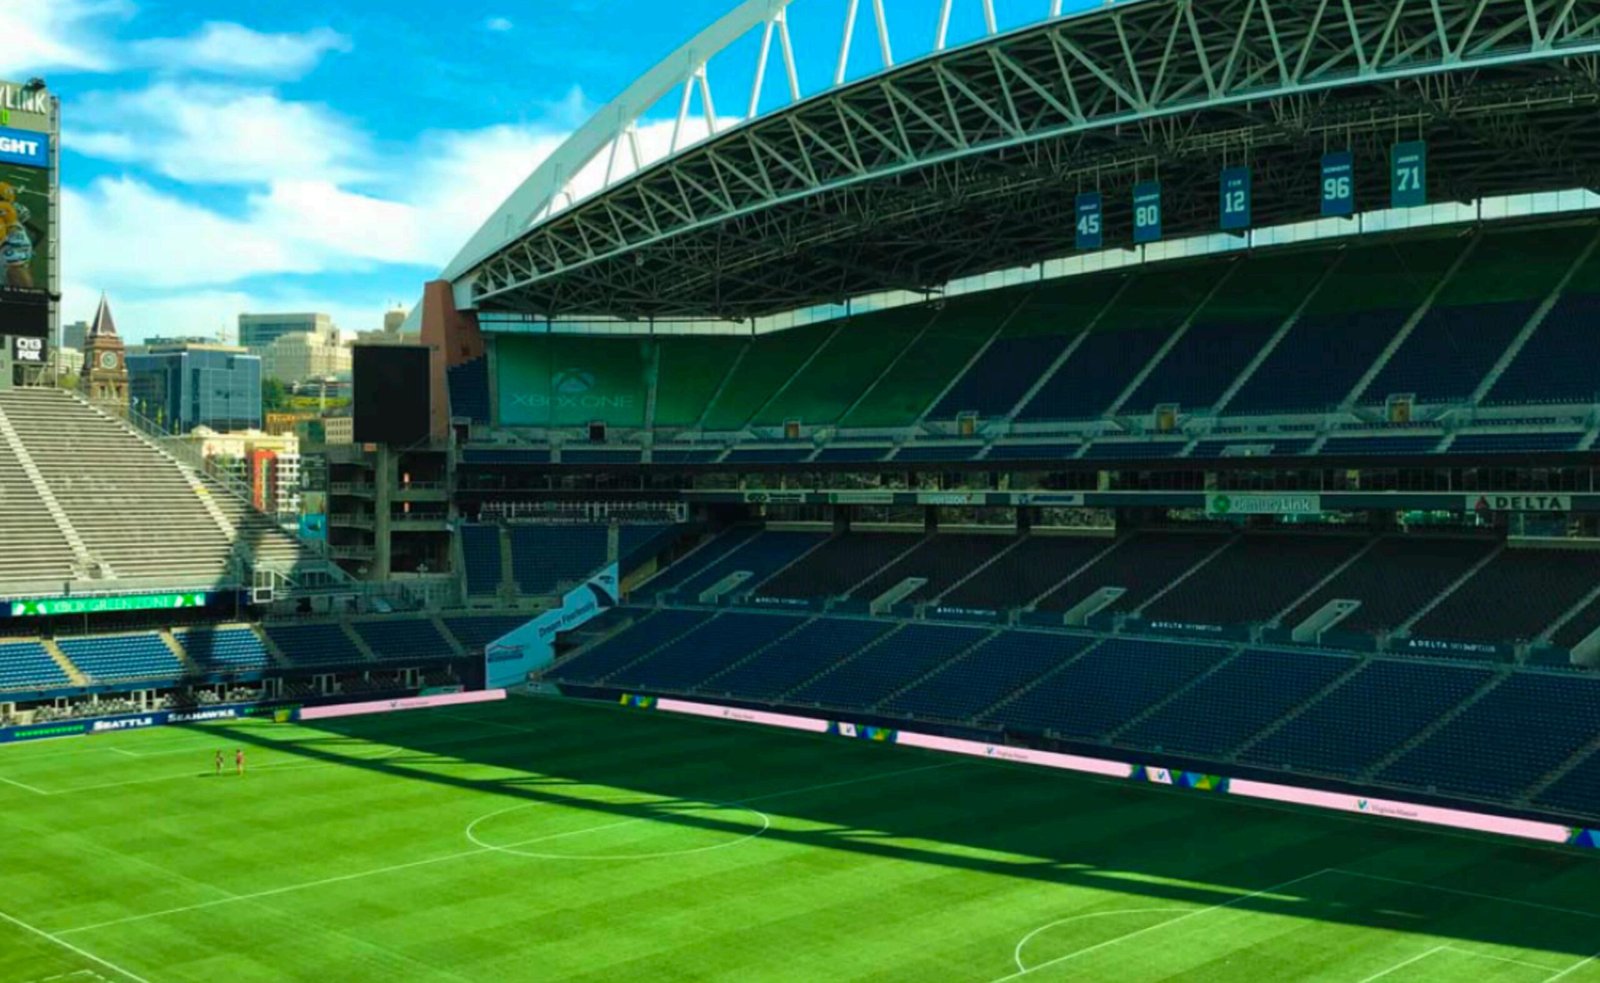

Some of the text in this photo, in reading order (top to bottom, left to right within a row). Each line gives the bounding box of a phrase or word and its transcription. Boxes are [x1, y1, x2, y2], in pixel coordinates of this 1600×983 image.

[1324, 176, 1350, 201] 96
[1396, 166, 1420, 191] 71
[1225, 190, 1245, 213] 12
[1078, 213, 1100, 236] 45
[1136, 205, 1159, 228] 80
[17, 350, 41, 361] FOX
[511, 394, 633, 408] XBOX ONE
[1496, 497, 1561, 509] DELTA
[1417, 640, 1448, 649] DELTA
[94, 717, 153, 731] SEATTLE
[167, 708, 235, 723] SEAHAWKS
